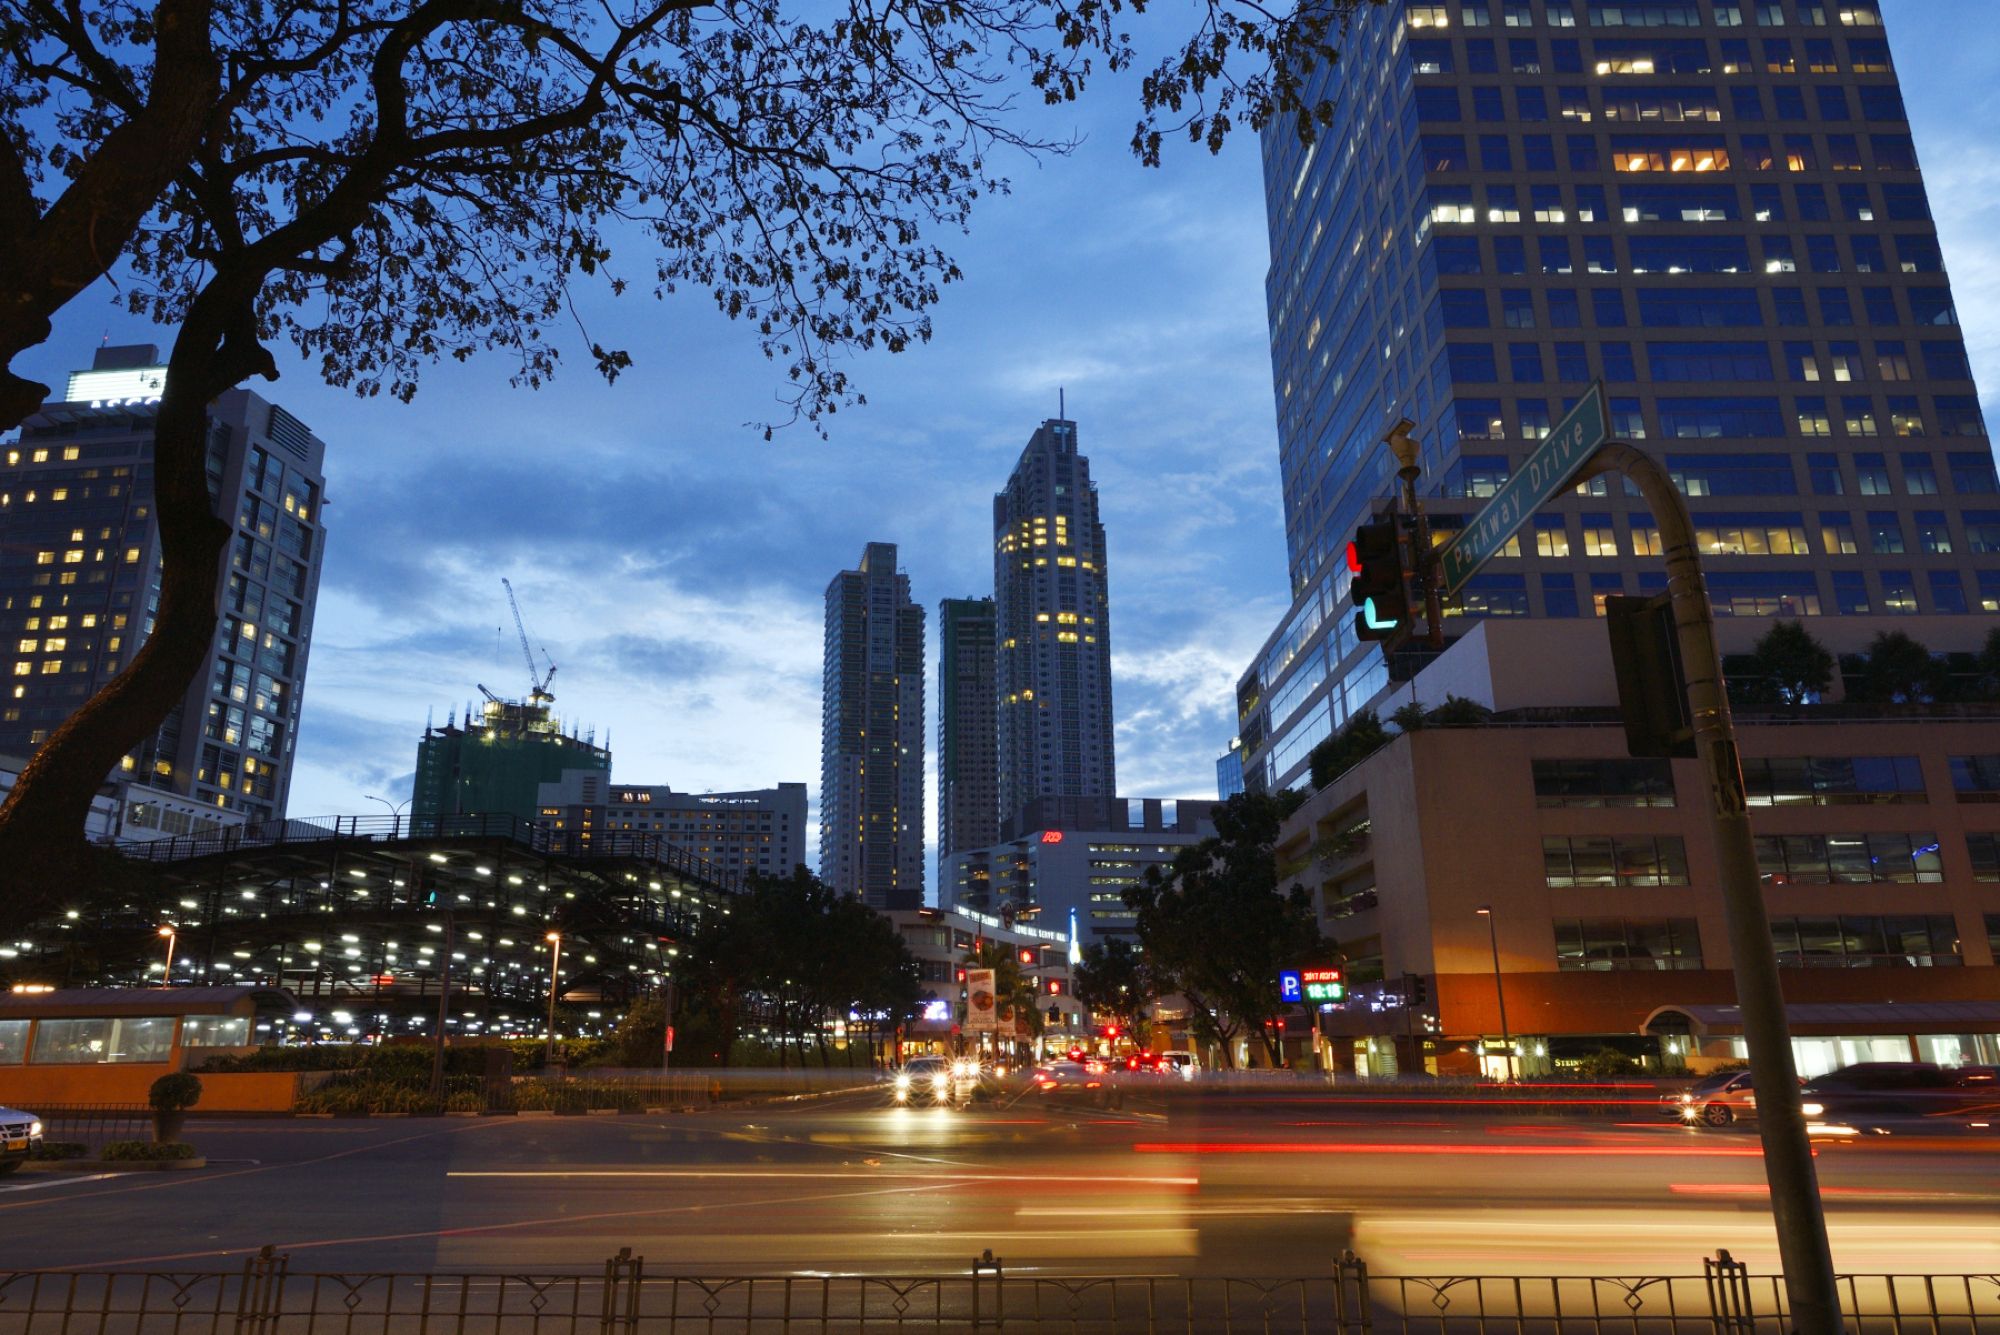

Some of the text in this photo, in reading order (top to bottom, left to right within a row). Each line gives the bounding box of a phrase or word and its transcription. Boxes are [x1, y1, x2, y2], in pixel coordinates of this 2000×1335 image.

[1453, 421, 1583, 573] Parkway Drive
[1014, 924, 1028, 935] LOVE
[1038, 929, 1054, 940] SERVE
[1284, 976, 1297, 996] P
